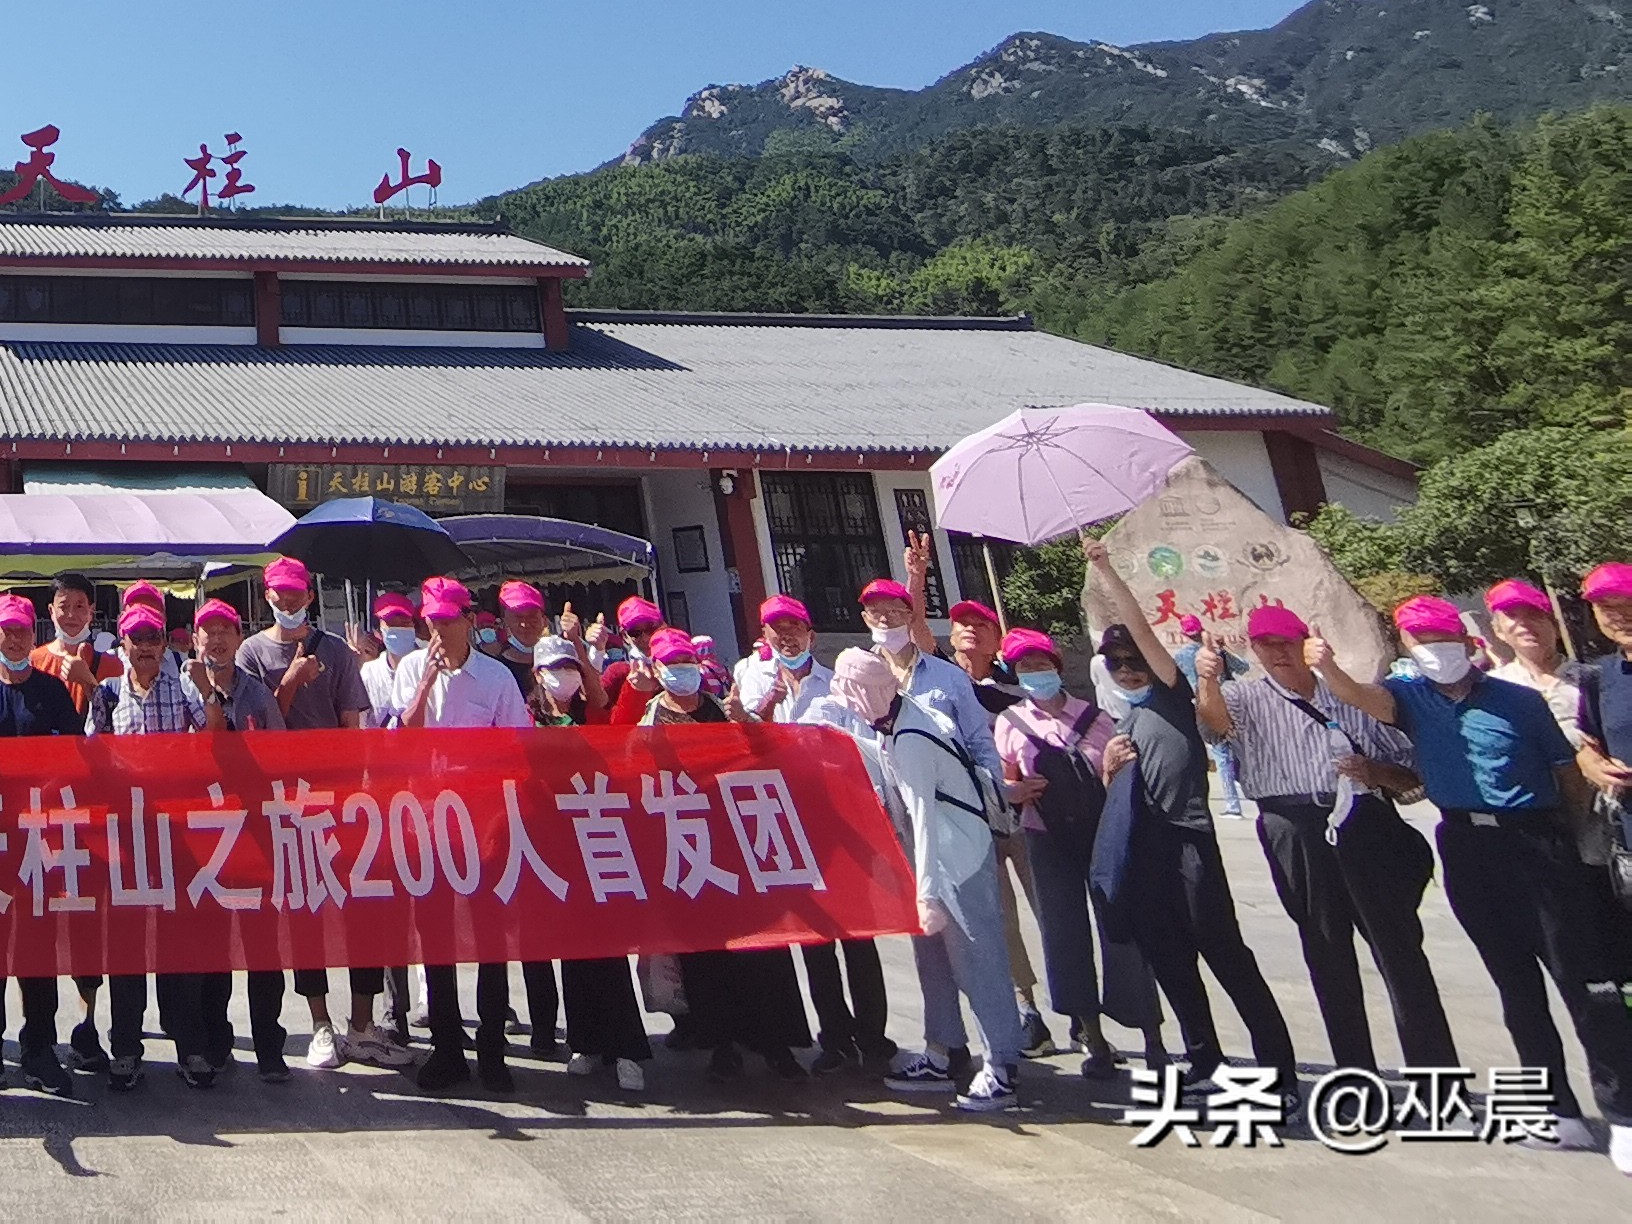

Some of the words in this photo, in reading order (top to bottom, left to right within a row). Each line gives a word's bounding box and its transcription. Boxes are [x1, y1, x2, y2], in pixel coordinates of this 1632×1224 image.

[328, 470, 490, 496] 天柱山游客中心
[1151, 588, 1285, 626] 天柱
